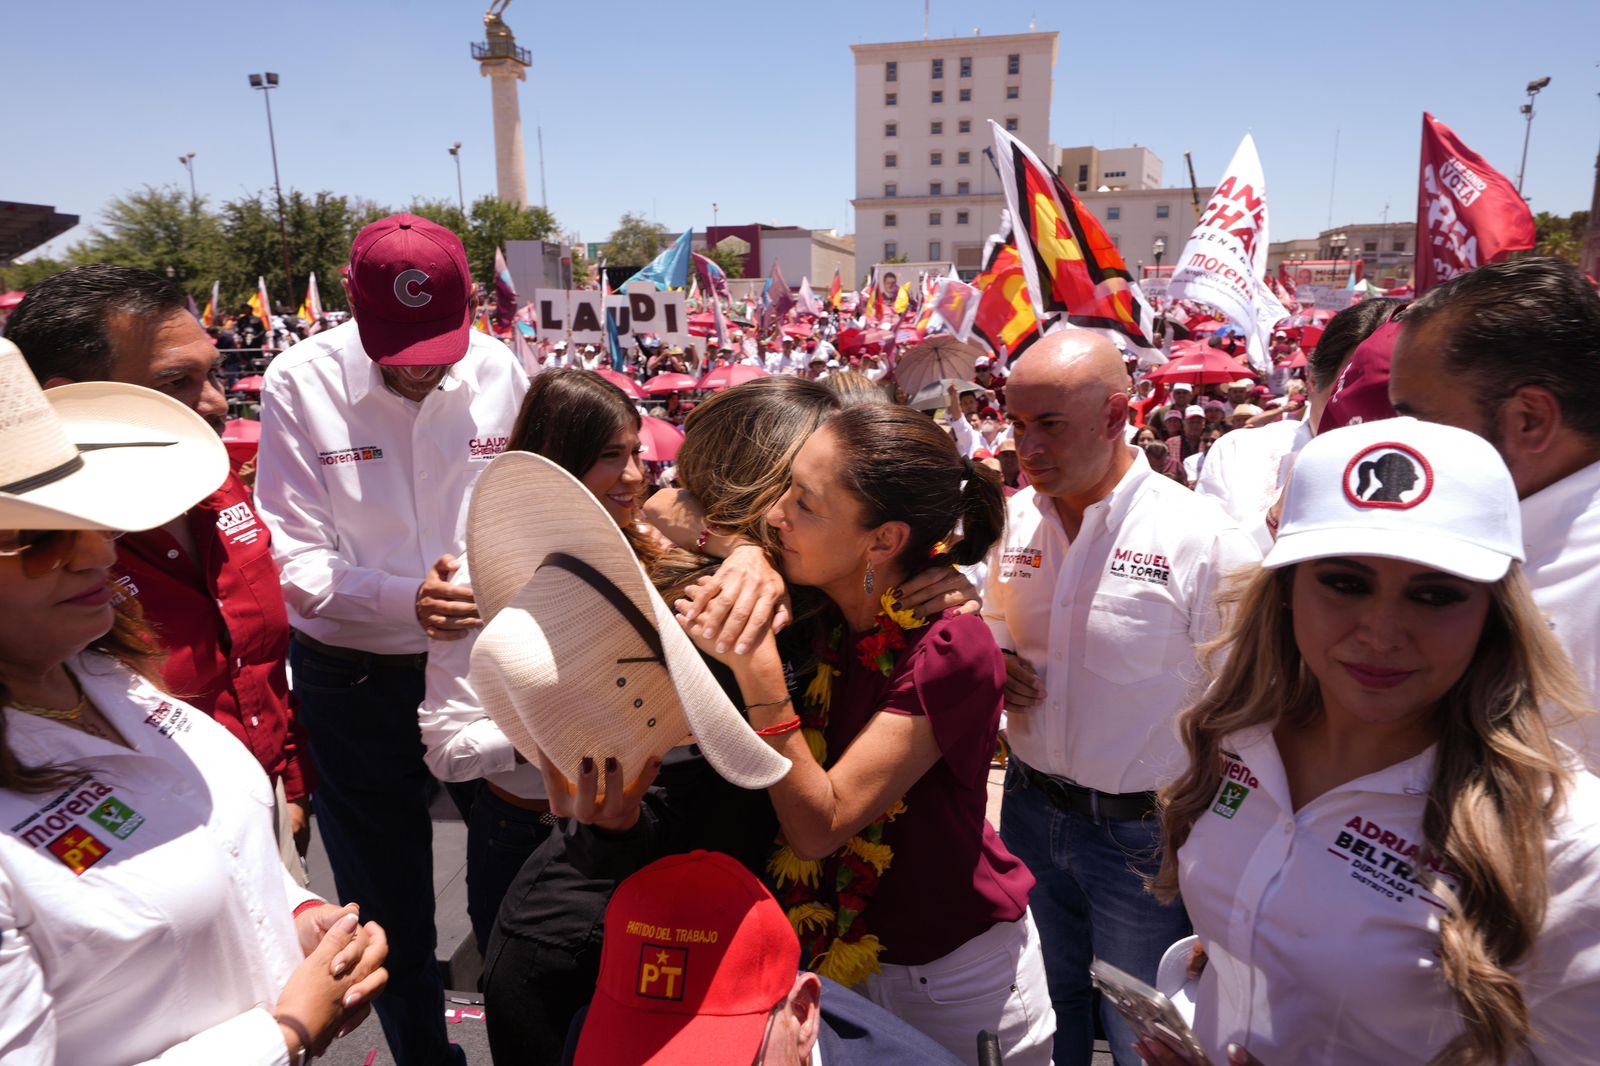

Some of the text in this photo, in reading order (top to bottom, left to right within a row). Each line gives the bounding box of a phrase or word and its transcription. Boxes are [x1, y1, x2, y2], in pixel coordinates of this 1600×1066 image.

[1212, 176, 1263, 214] AN
[1440, 163, 1478, 206] VOTA
[394, 268, 432, 308] C
[318, 451, 362, 466] morena
[217, 504, 252, 528] CRUZ
[1111, 560, 1125, 573] LA
[1130, 564, 1170, 581] TORRE
[1114, 547, 1170, 570] MIGUEL
[21, 781, 113, 848] morena
[63, 835, 102, 871] PT
[1351, 858, 1415, 896] DIPUTADA
[1351, 870, 1395, 899] DISTRITO
[626, 920, 719, 944] PARTIDO DEL TRABAJO
[640, 963, 682, 998] PT
